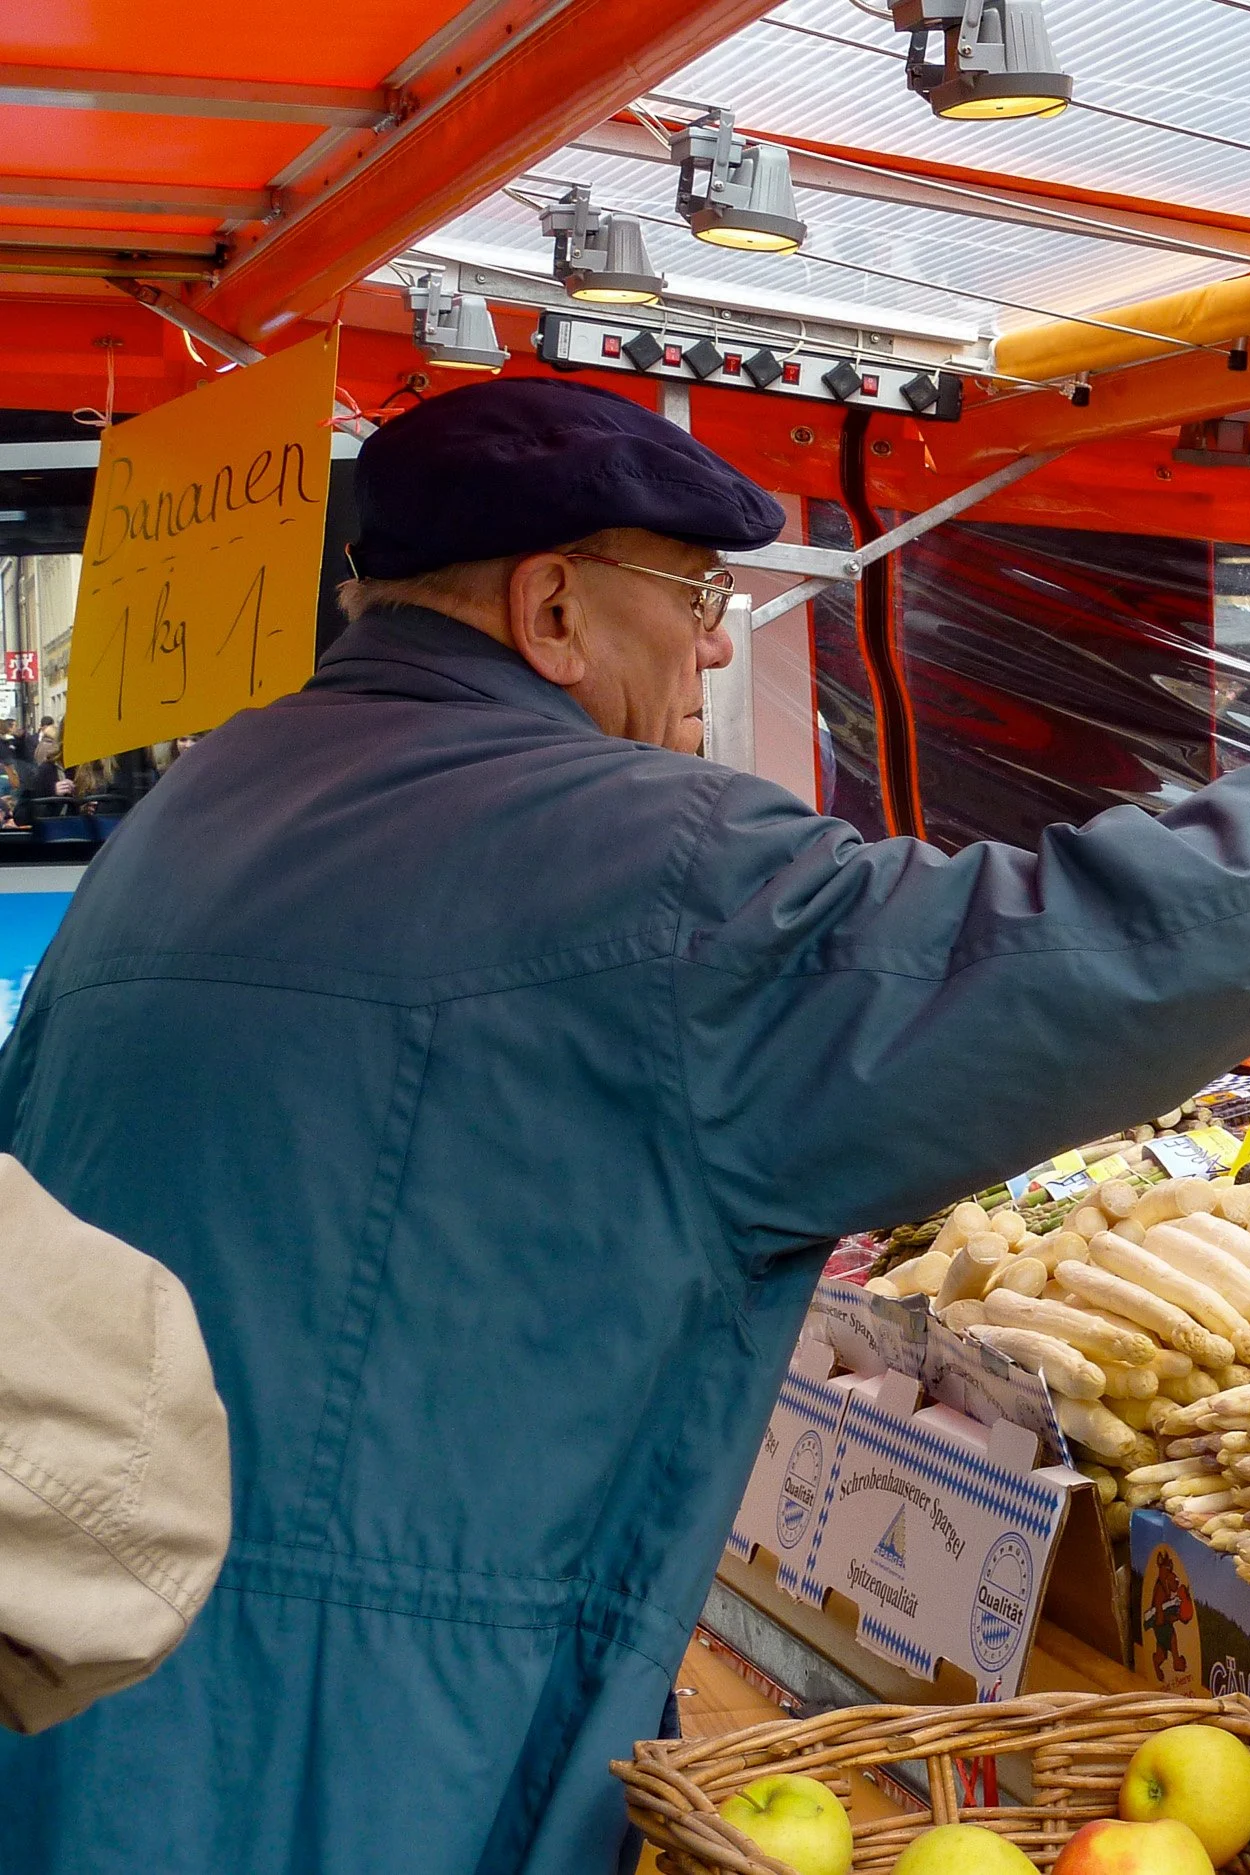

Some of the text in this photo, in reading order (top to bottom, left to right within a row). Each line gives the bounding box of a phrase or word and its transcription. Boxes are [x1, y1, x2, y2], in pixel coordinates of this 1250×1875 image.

[93, 442, 320, 567] Bananen
[91, 606, 129, 721] 1
[146, 580, 188, 704] kg
[784, 1477, 815, 1507] Qualität
[839, 1466, 967, 1562] Schrobenhausener Spargel
[846, 1558, 920, 1619] Spitzenqualität
[977, 1585, 1025, 1627] Qualität
